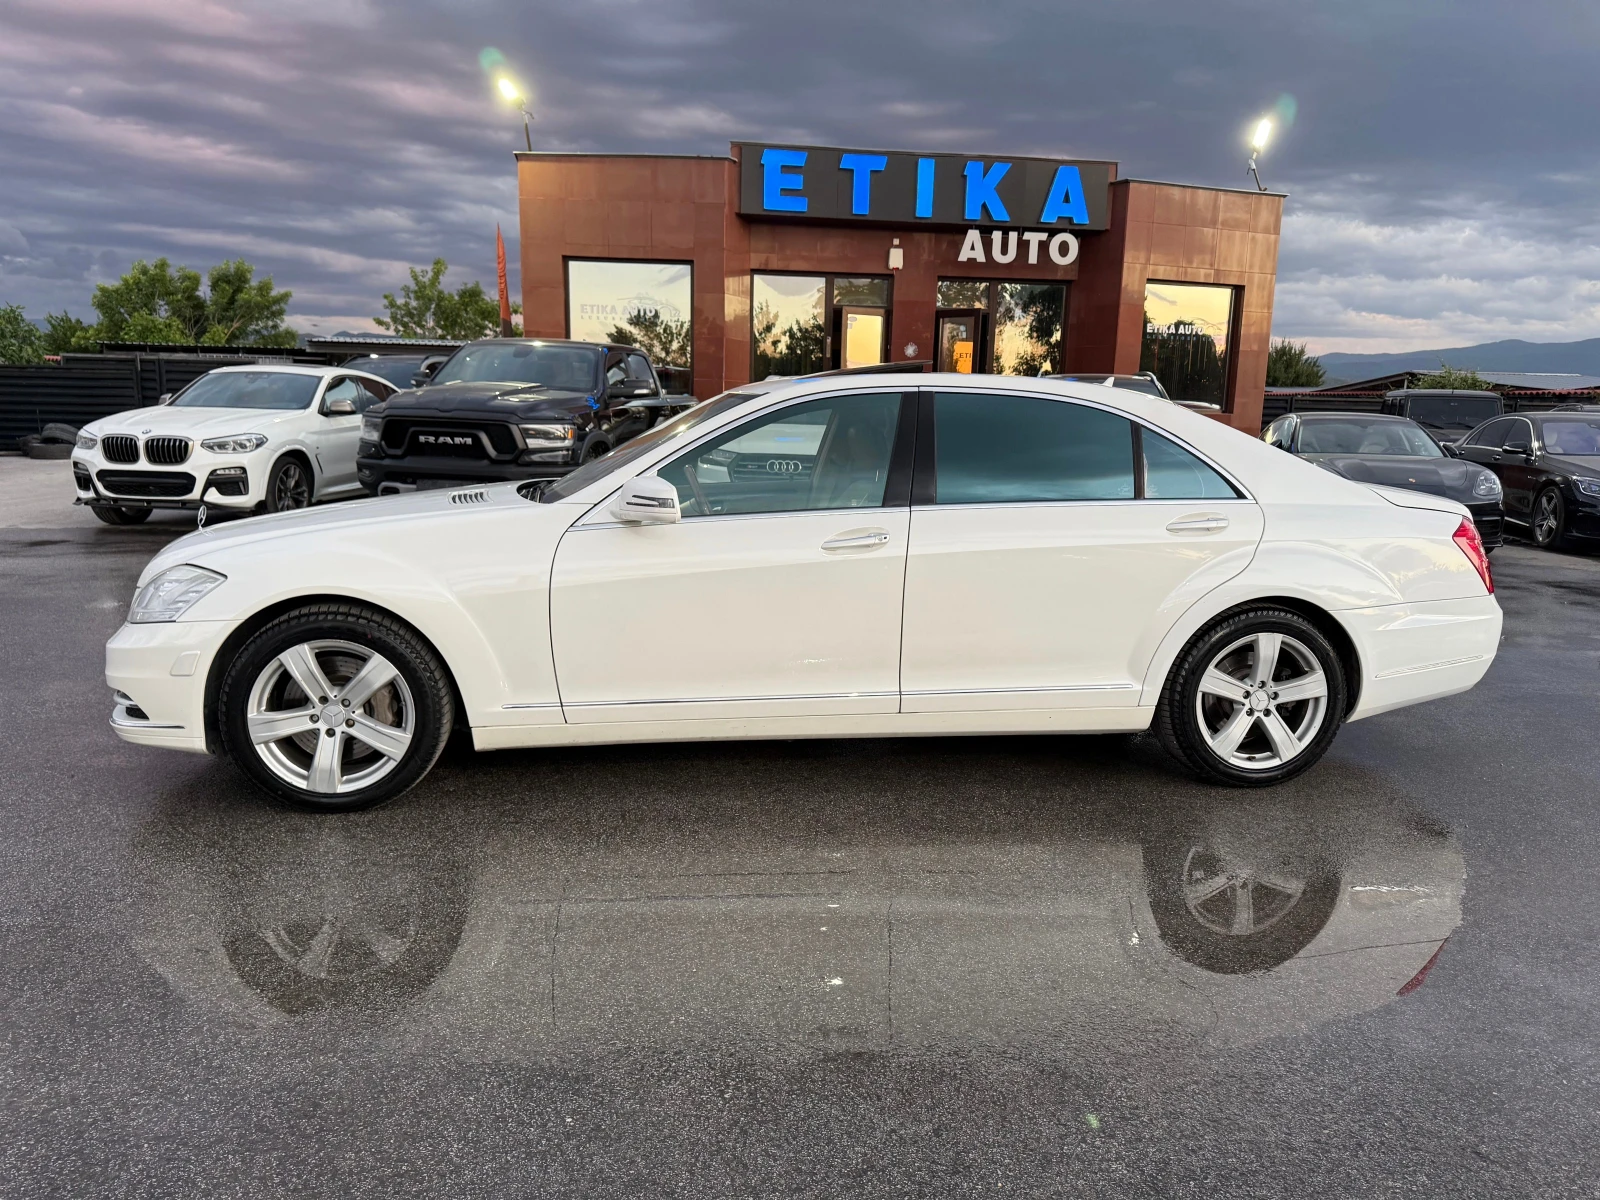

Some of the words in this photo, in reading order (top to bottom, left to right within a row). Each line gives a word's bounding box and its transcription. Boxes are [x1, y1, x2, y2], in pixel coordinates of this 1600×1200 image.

[760, 148, 1090, 225] ETIKA
[957, 228, 1080, 266] AUTO
[580, 303, 618, 316] ETIKA
[621, 305, 656, 317] AUTO
[1146, 322, 1176, 335] ETIKA
[1178, 324, 1205, 335] AUTO
[418, 435, 472, 445] RAM
